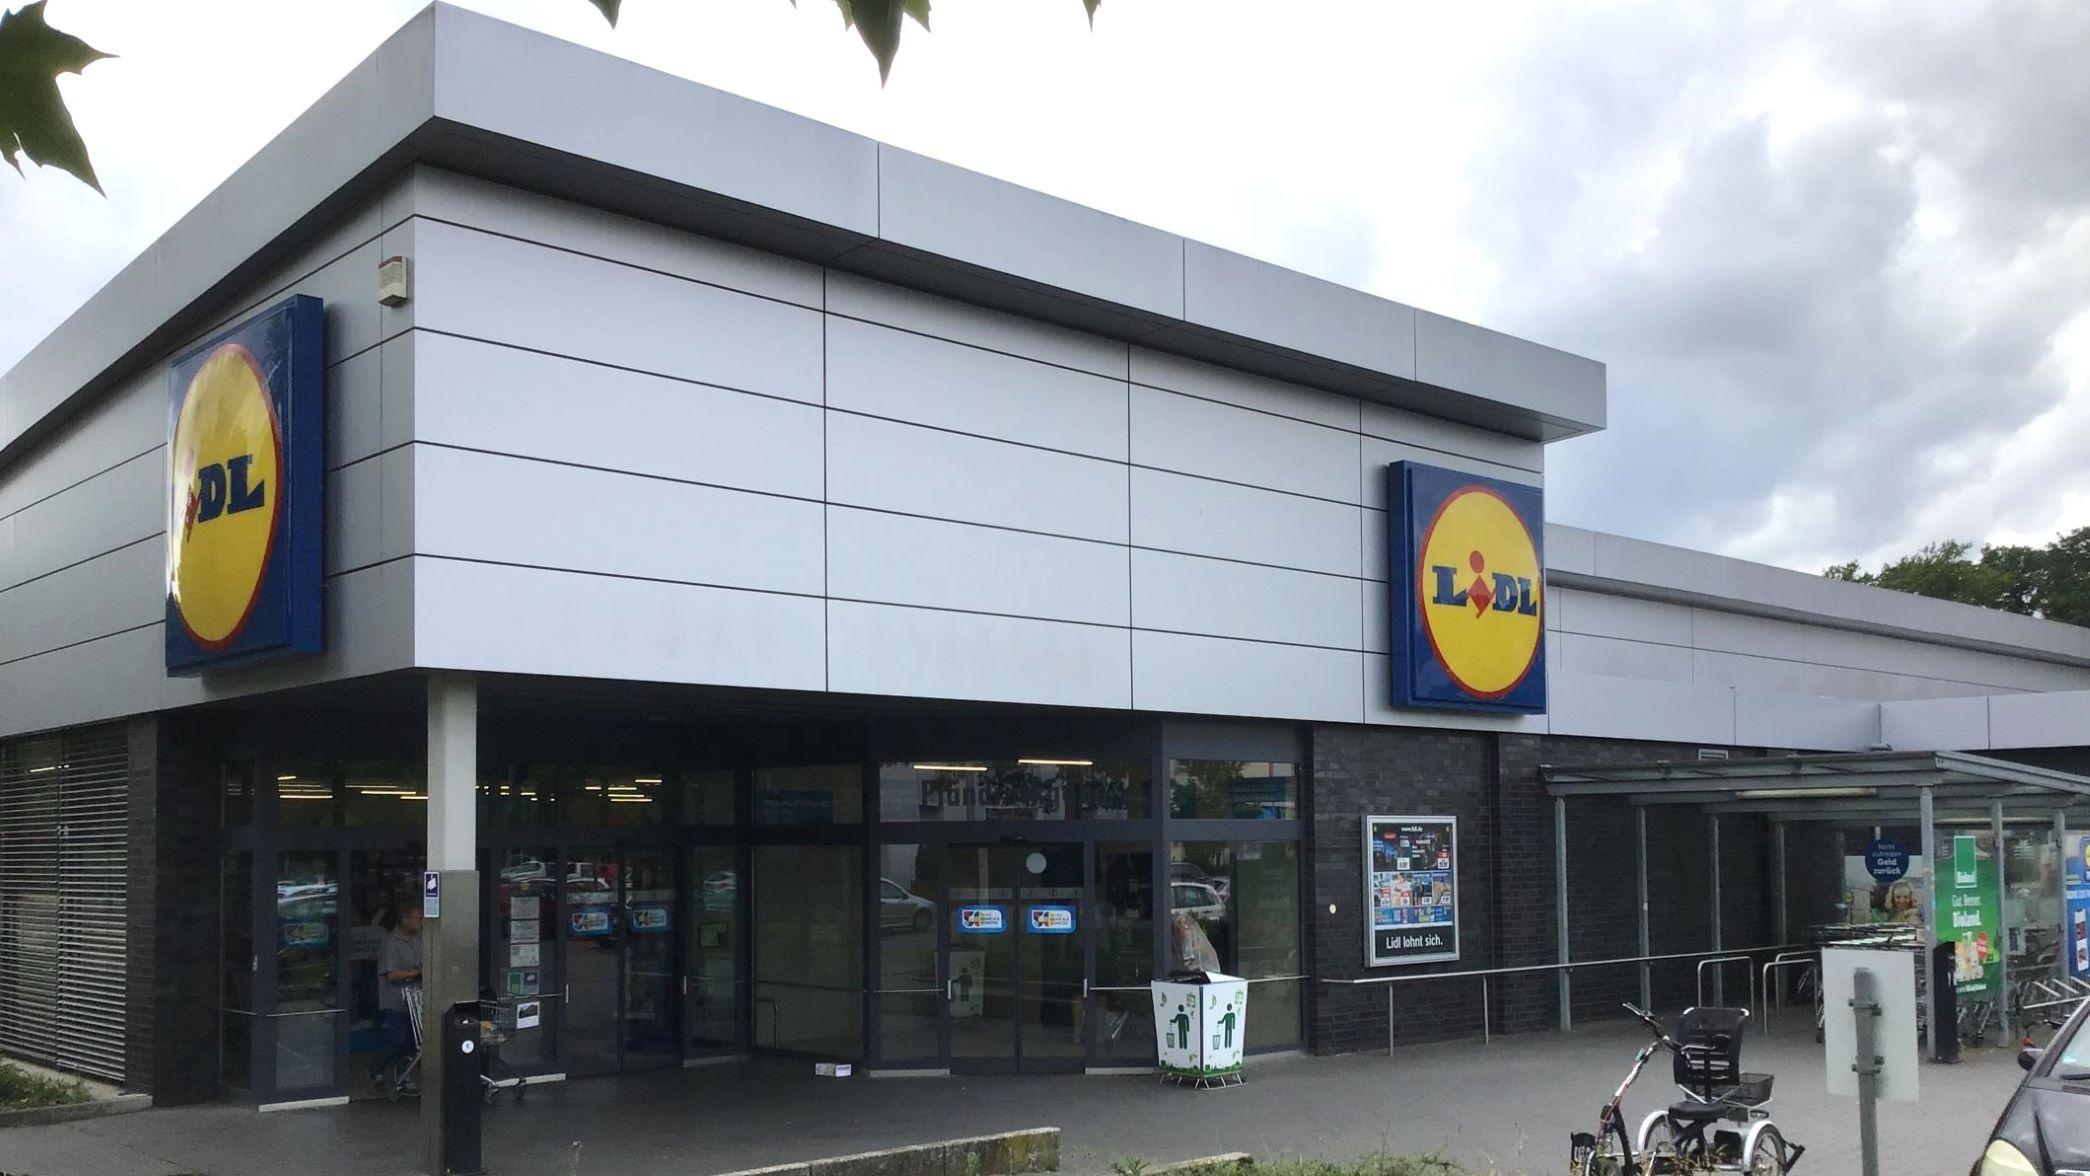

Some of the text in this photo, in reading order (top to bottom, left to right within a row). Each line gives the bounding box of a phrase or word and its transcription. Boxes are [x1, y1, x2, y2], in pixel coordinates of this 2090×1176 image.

[1877, 858, 1898, 866] Geld
[1873, 867, 1901, 875] zurück
[1386, 933, 1443, 949] Lidl lohnt sich.
